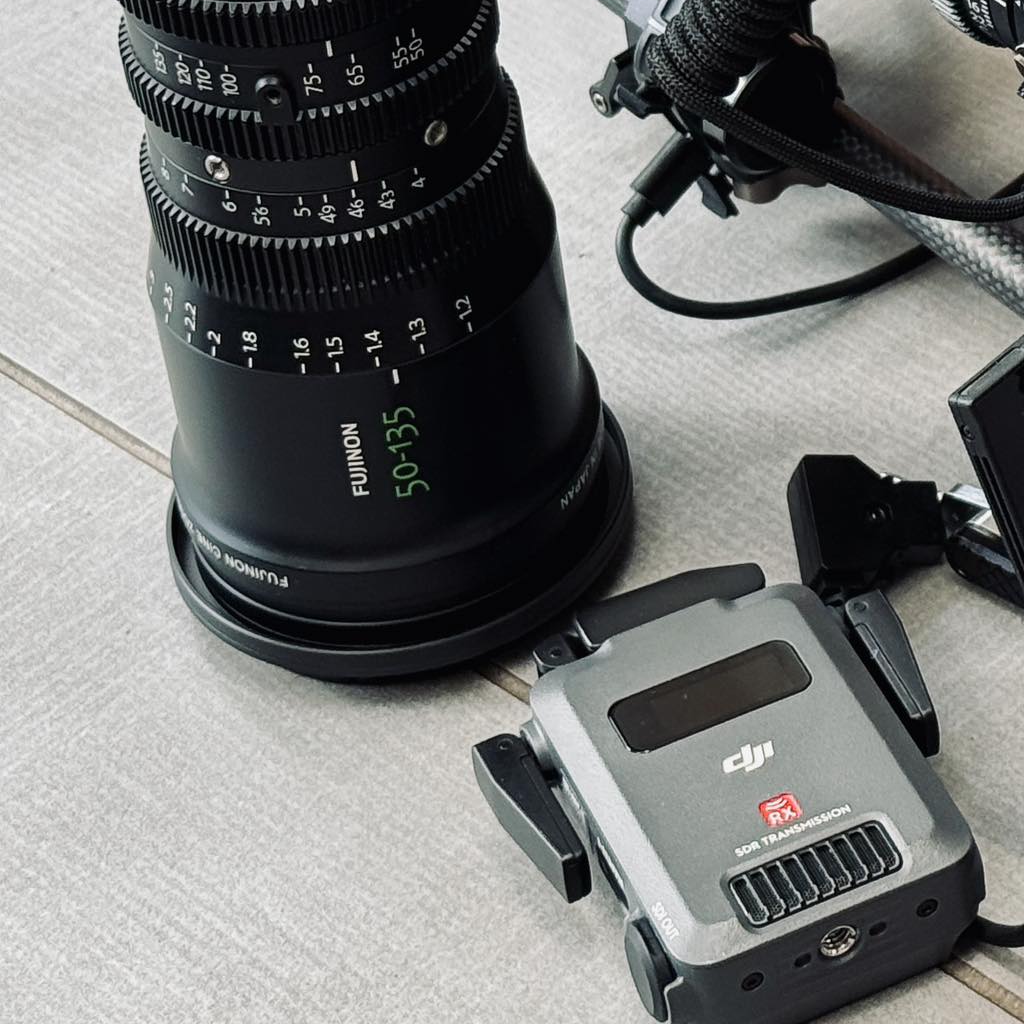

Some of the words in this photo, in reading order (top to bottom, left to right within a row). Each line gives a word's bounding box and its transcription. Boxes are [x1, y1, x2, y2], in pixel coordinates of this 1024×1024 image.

[392, 47, 409, 69] 55
[408, 38, 425, 61] 50
[175, 61, 193, 86] 120
[195, 67, 214, 91] 110
[346, 64, 366, 86] 65
[220, 73, 240, 97] 100
[303, 75, 324, 96] 75
[411, 176, 426, 188] 4
[221, 200, 238, 212] 6
[294, 207, 312, 217] 5
[455, 295, 473, 320] 1.2
[207, 330, 221, 345] 2
[408, 317, 427, 341] 1.3
[242, 331, 258, 353] 1.8
[293, 337, 311, 359] 1.6
[325, 336, 344, 358] 1.5
[364, 329, 383, 353] 1.4
[340, 423, 370, 497] FUJINON
[382, 406, 430, 498] 50-135
[225, 553, 289, 588] FUJINON
[767, 805, 797, 826] RX
[734, 840, 762, 857] SDR
[760, 804, 852, 846] TRANSMISSION
